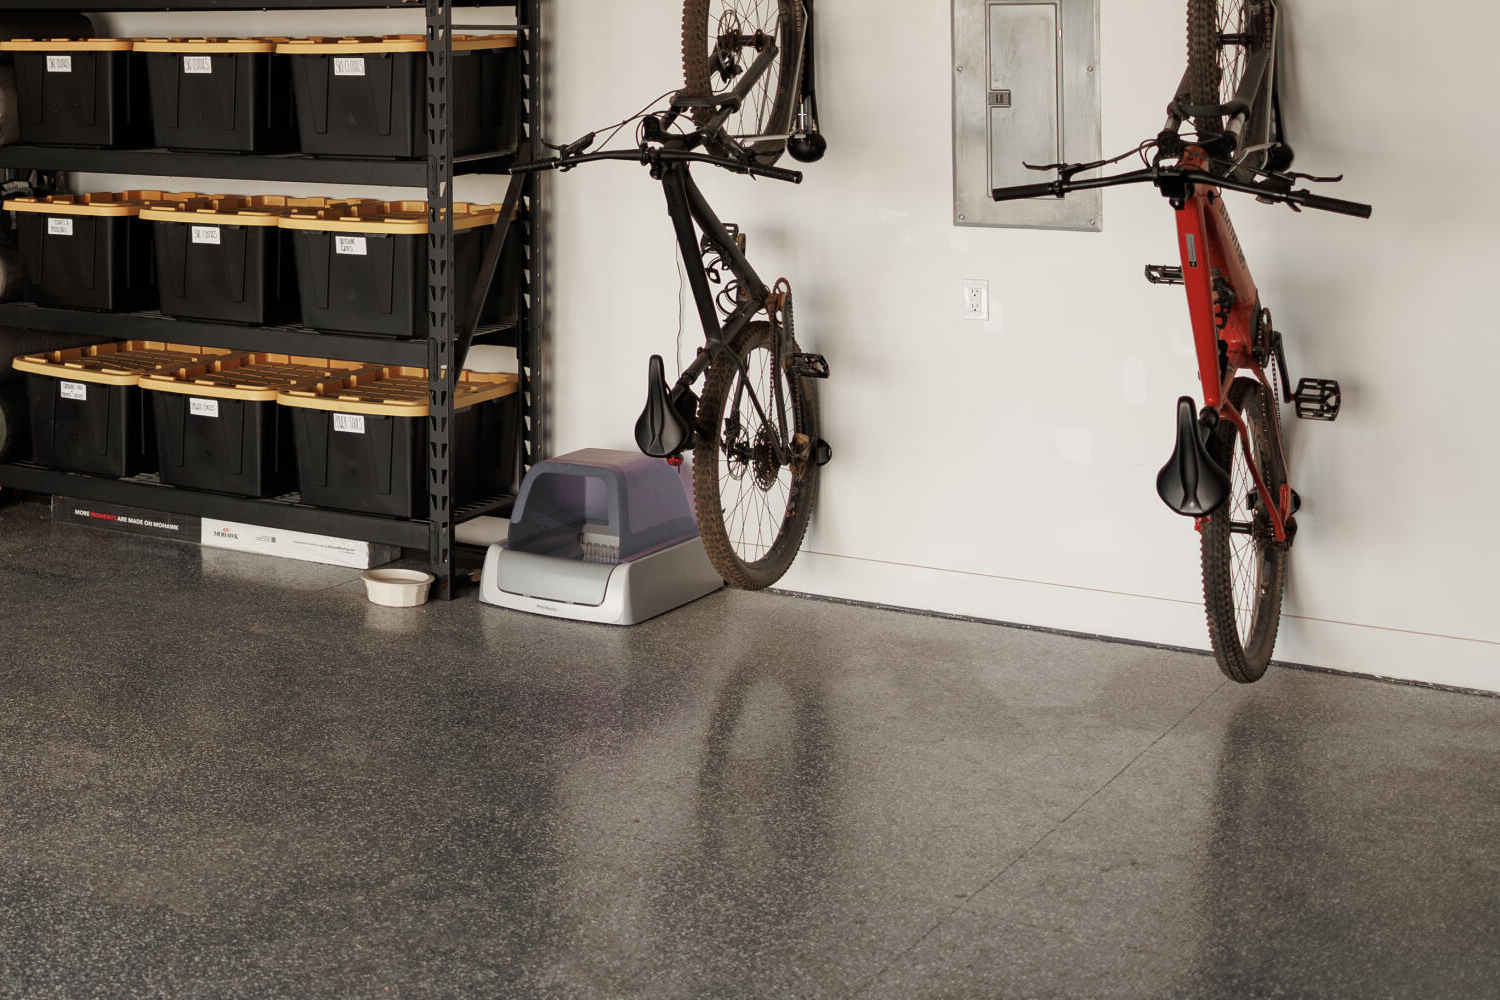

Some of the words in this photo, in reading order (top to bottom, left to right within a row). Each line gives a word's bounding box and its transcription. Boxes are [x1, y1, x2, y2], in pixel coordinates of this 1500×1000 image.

[74, 509, 90, 517] MORE
[90, 511, 117, 521] MOMENTS
[128, 518, 143, 526] MADE
[153, 521, 179, 531] MOHAWK
[213, 530, 239, 540] MOHAWK
